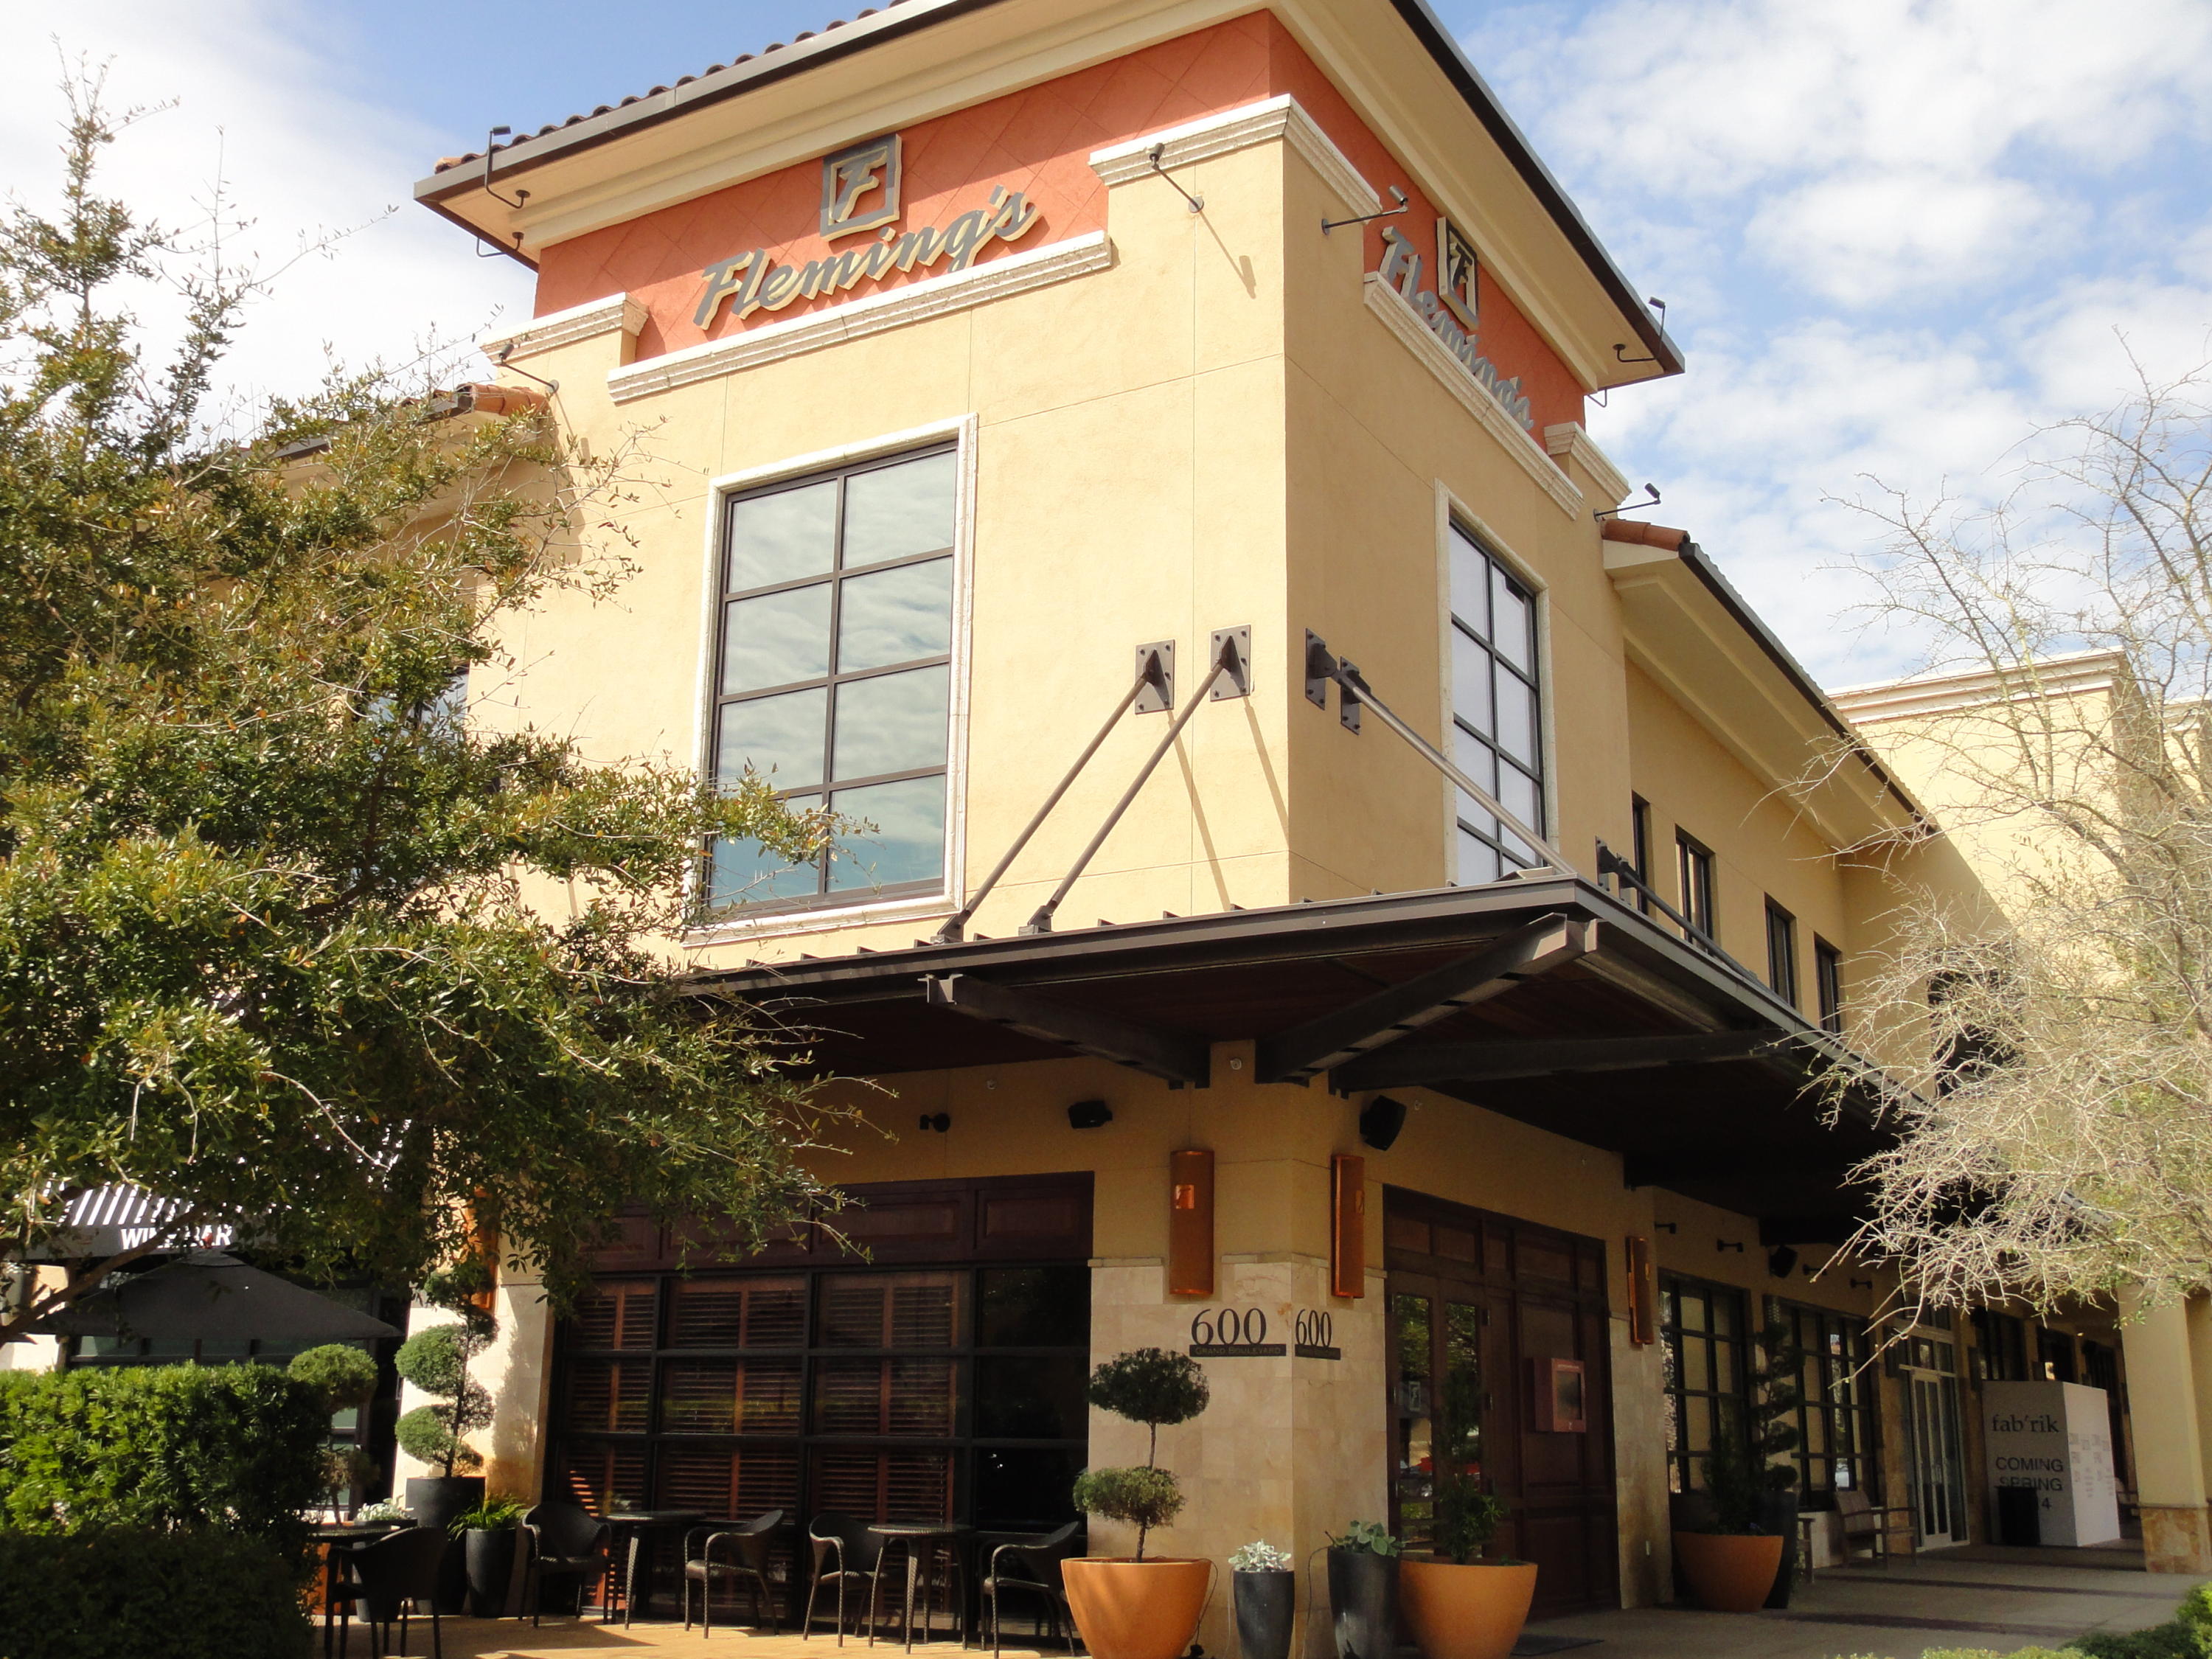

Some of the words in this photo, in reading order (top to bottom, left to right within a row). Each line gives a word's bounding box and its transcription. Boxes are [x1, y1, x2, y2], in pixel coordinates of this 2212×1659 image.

[693, 184, 1045, 330] Fleming's
[1191, 1308, 1267, 1346] 600
[1295, 1309, 1332, 1347] 600
[1992, 1414, 2059, 1433] fab'rik
[1995, 1456, 2064, 1472] COMING
